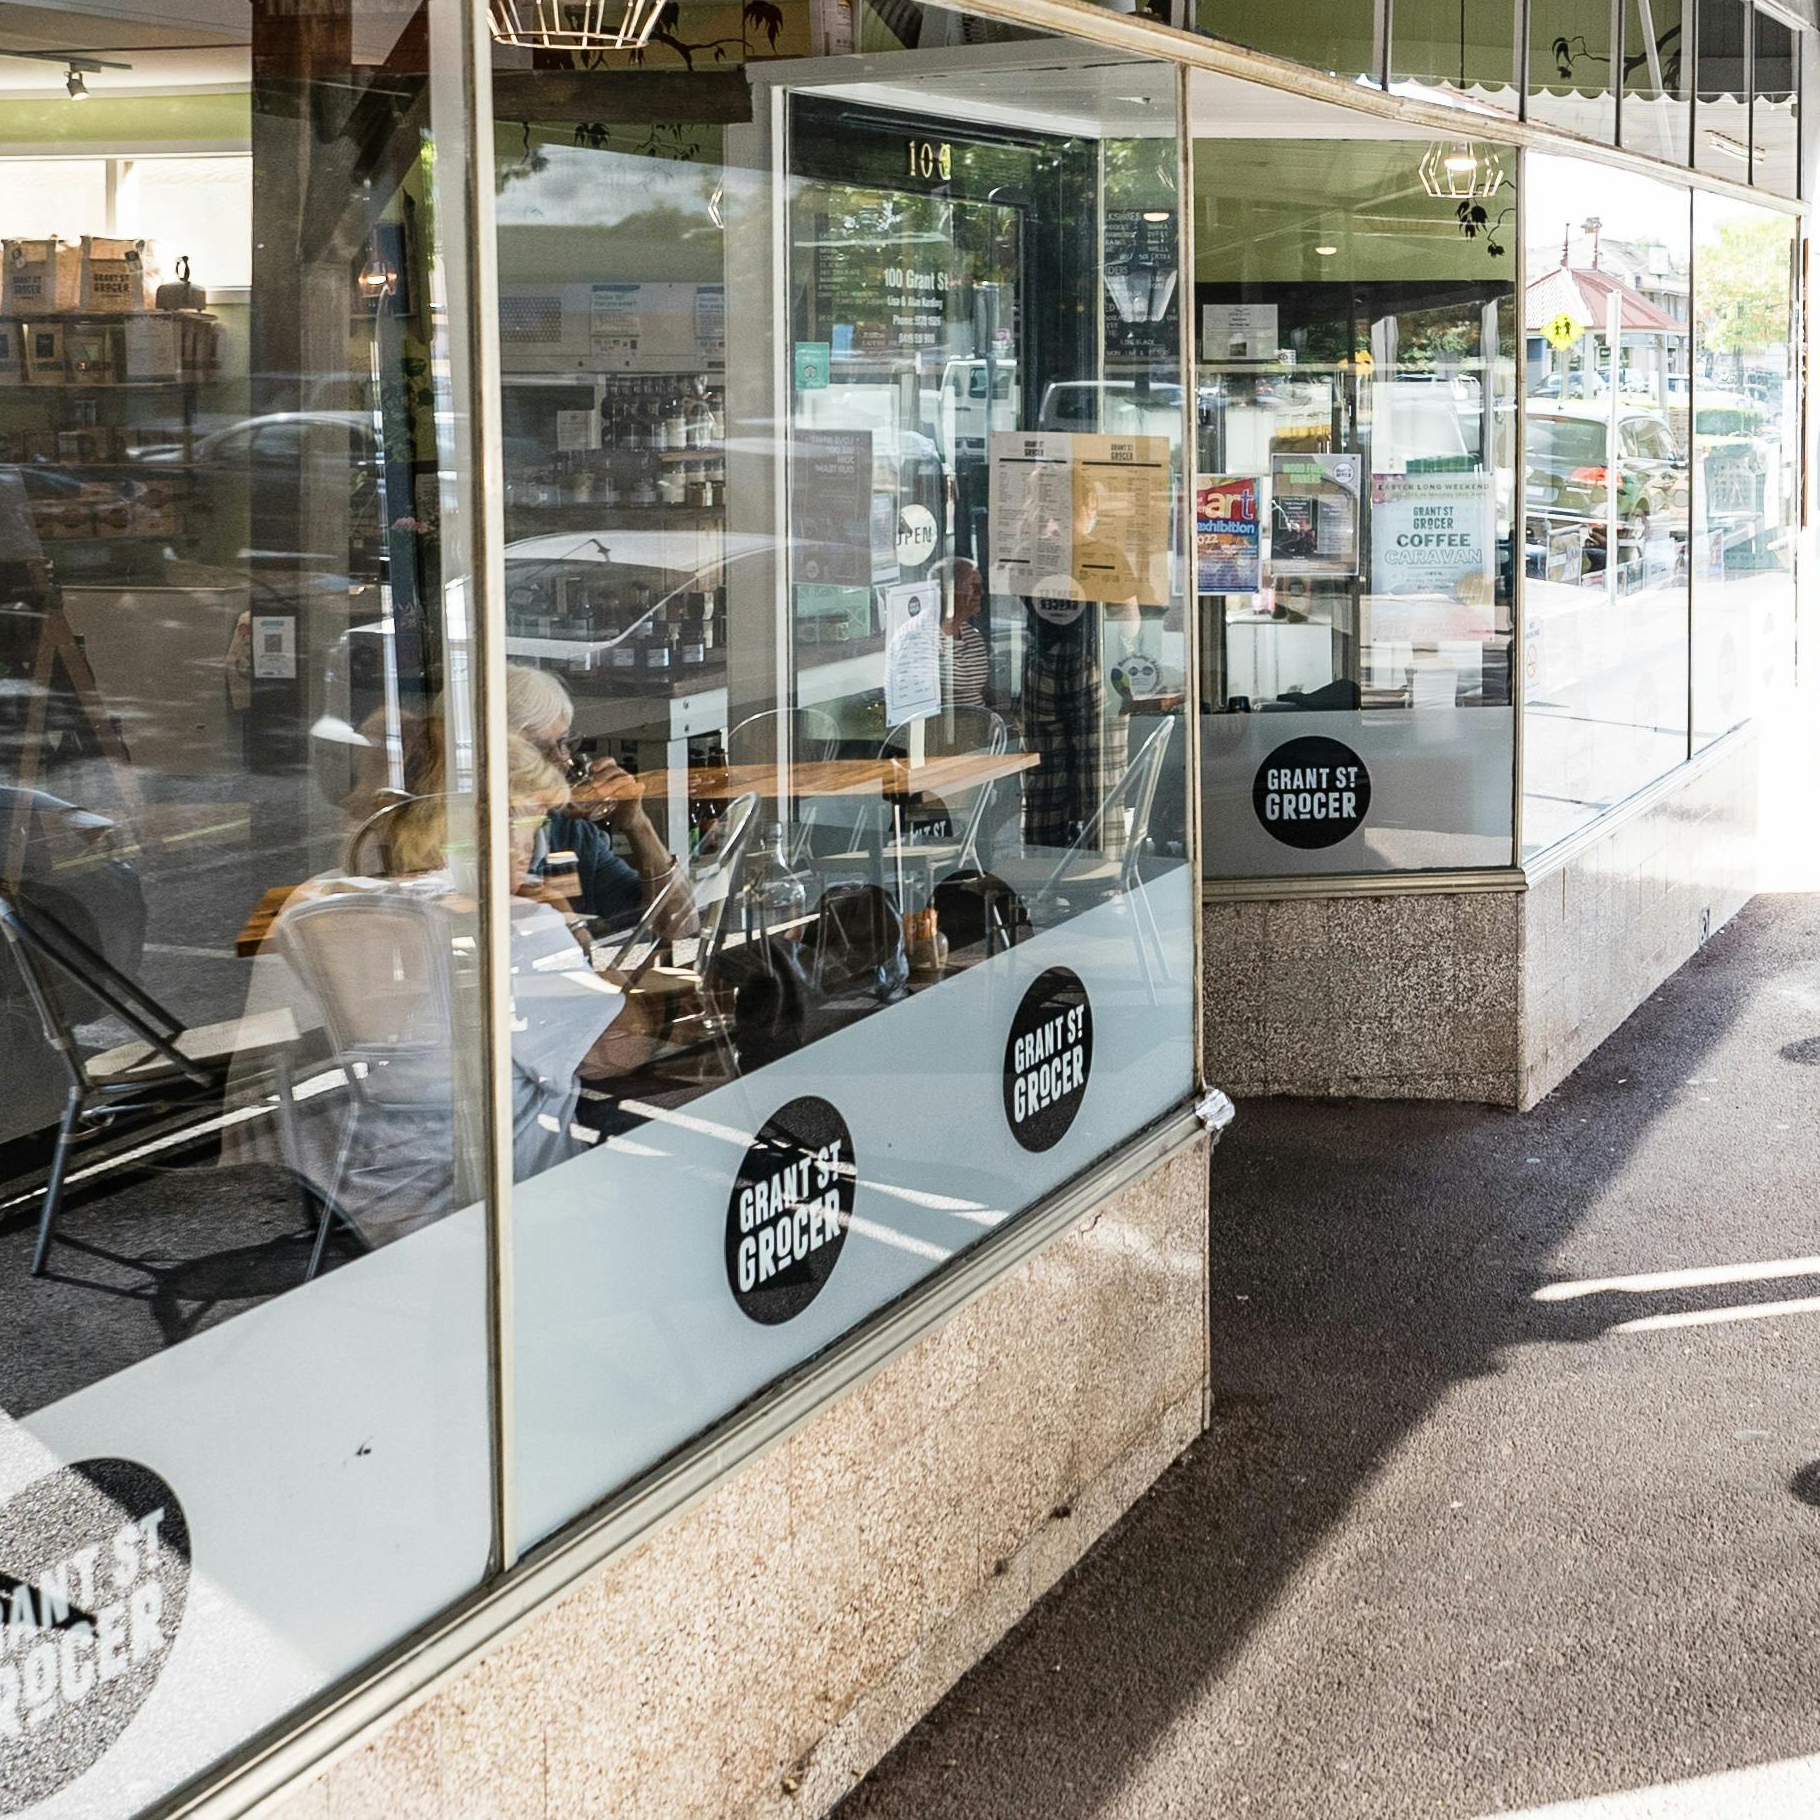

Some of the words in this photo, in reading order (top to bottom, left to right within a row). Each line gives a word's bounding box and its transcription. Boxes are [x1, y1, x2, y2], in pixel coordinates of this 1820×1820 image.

[884, 268, 903, 288] 100
[906, 269, 935, 291] Grant
[937, 271, 949, 291] St
[1204, 488, 1254, 520] art
[1413, 506, 1441, 516] GRANT
[1444, 506, 1454, 516] ST
[1413, 517, 1454, 530] GROCER
[1197, 534, 1219, 544] 022
[1396, 533, 1471, 548] COFFEE
[1384, 548, 1483, 565] CARAVAN
[1267, 767, 1331, 791] GRANT
[1335, 766, 1357, 788] ST
[1265, 791, 1357, 820] GROCER
[1014, 1014, 1063, 1071] GRANT
[1066, 1003, 1085, 1040] ST
[1013, 1045, 1084, 1124] GROCER
[739, 1158, 813, 1234] GRANT
[816, 1138, 842, 1190] ST
[737, 1192, 841, 1294] GROCER
[113, 1506, 166, 1587] ST
